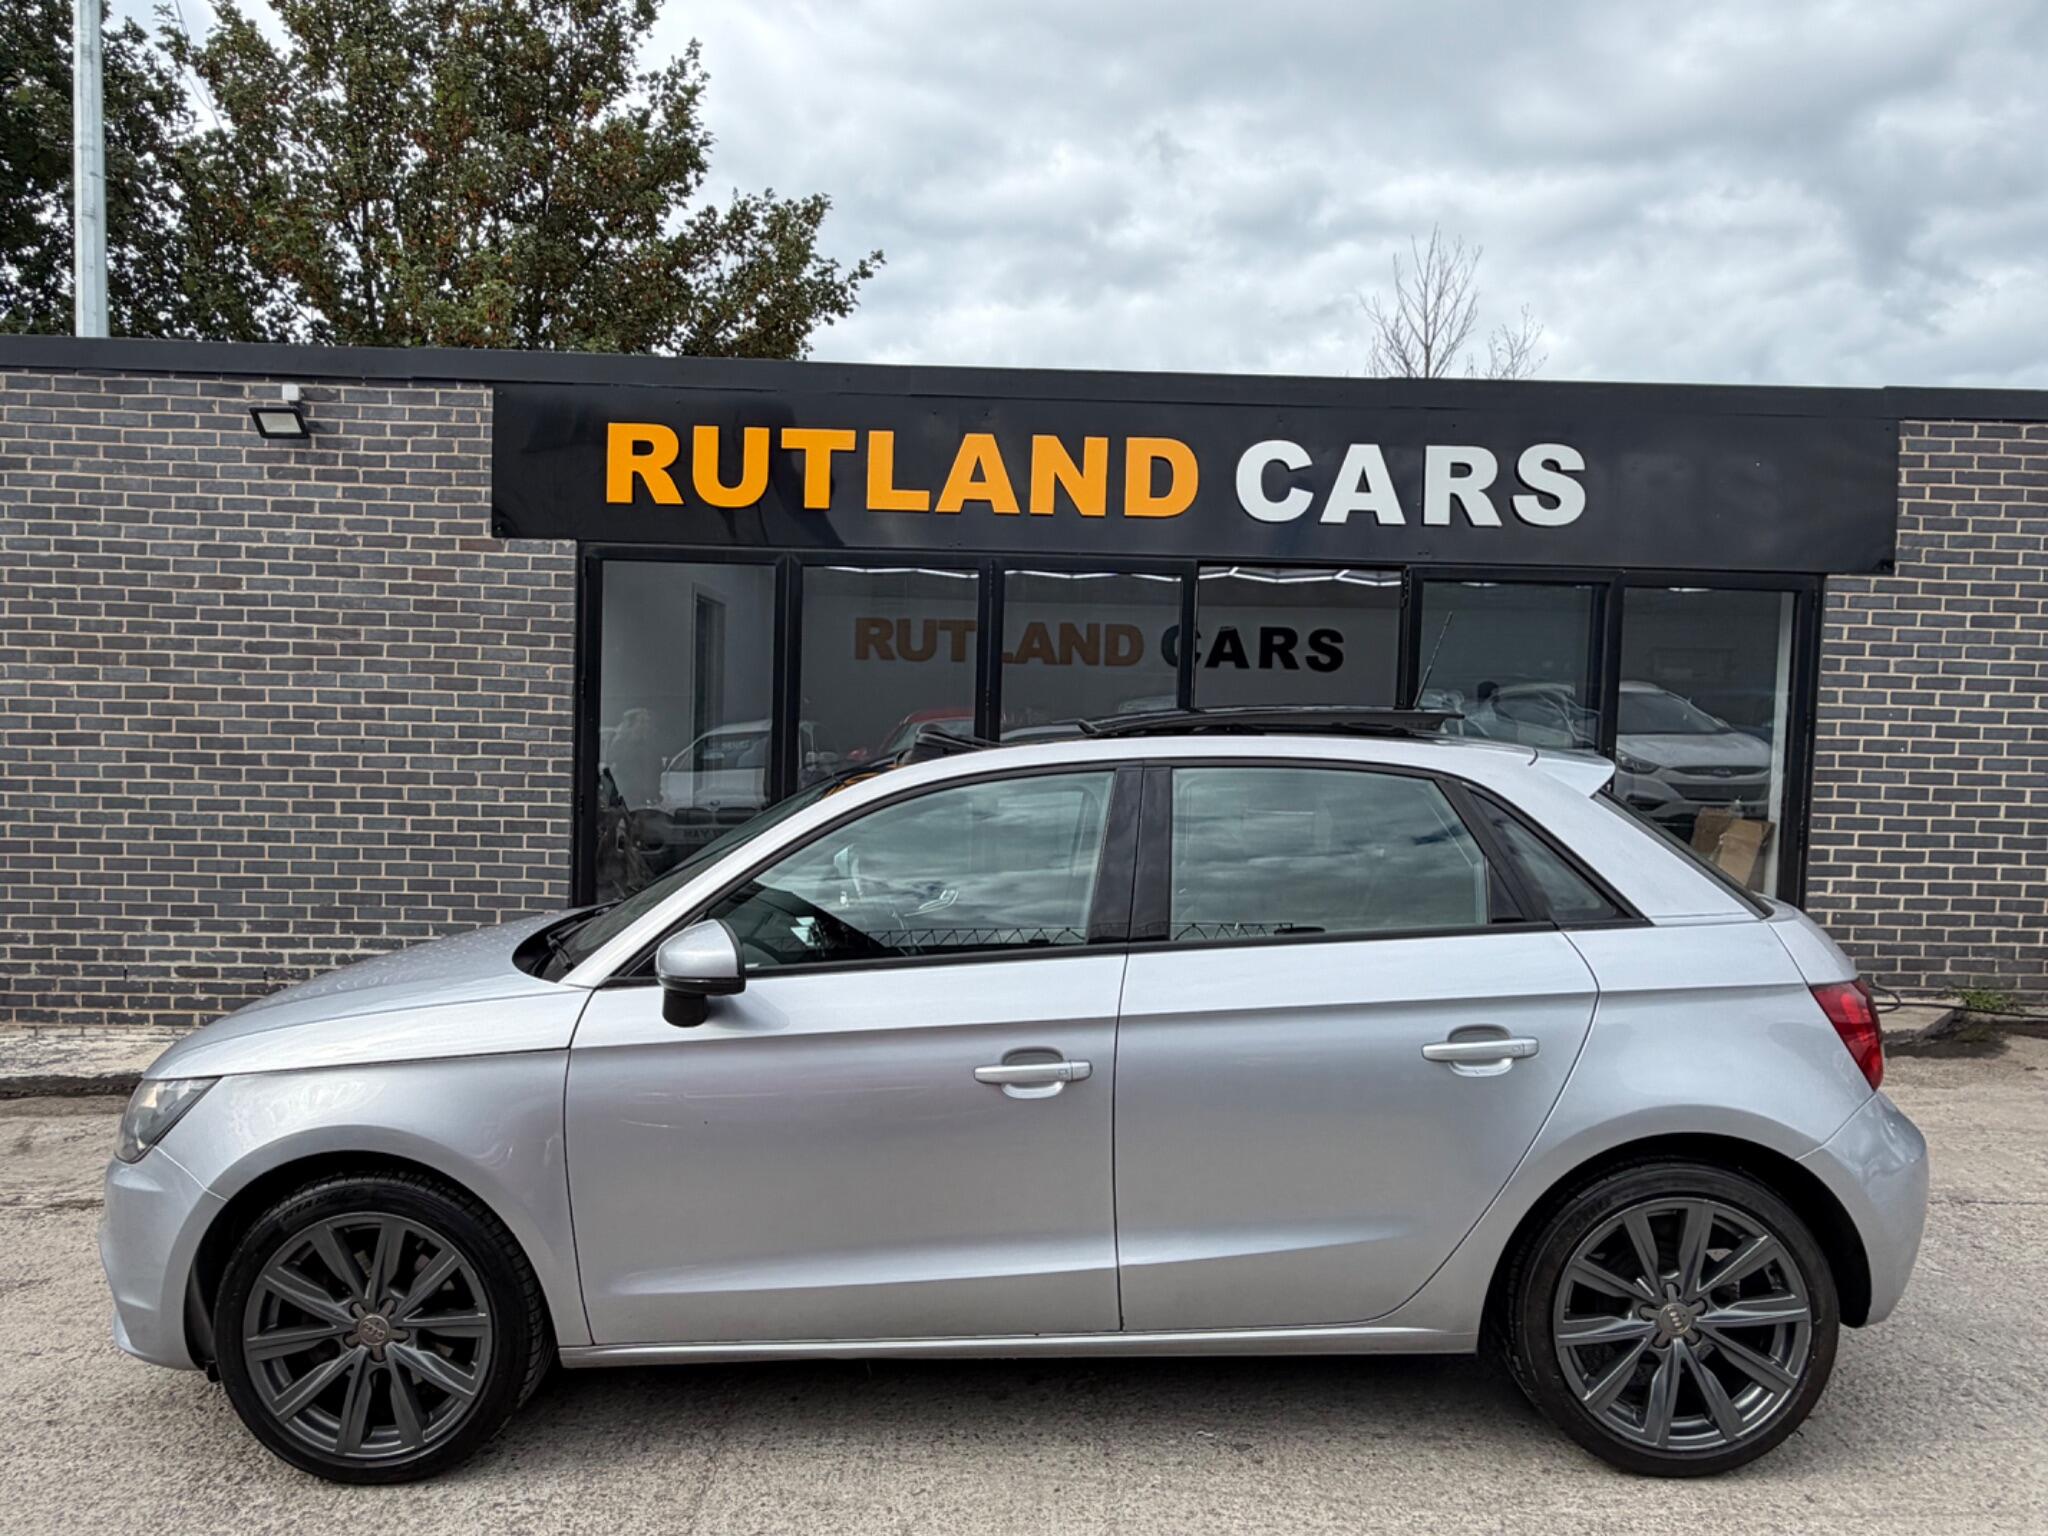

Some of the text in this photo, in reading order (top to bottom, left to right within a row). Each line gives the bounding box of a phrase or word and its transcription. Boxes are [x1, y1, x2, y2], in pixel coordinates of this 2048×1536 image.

[606, 422, 1587, 526] RUTLAND CARS
[854, 617, 1345, 673] RUTAND CARS
